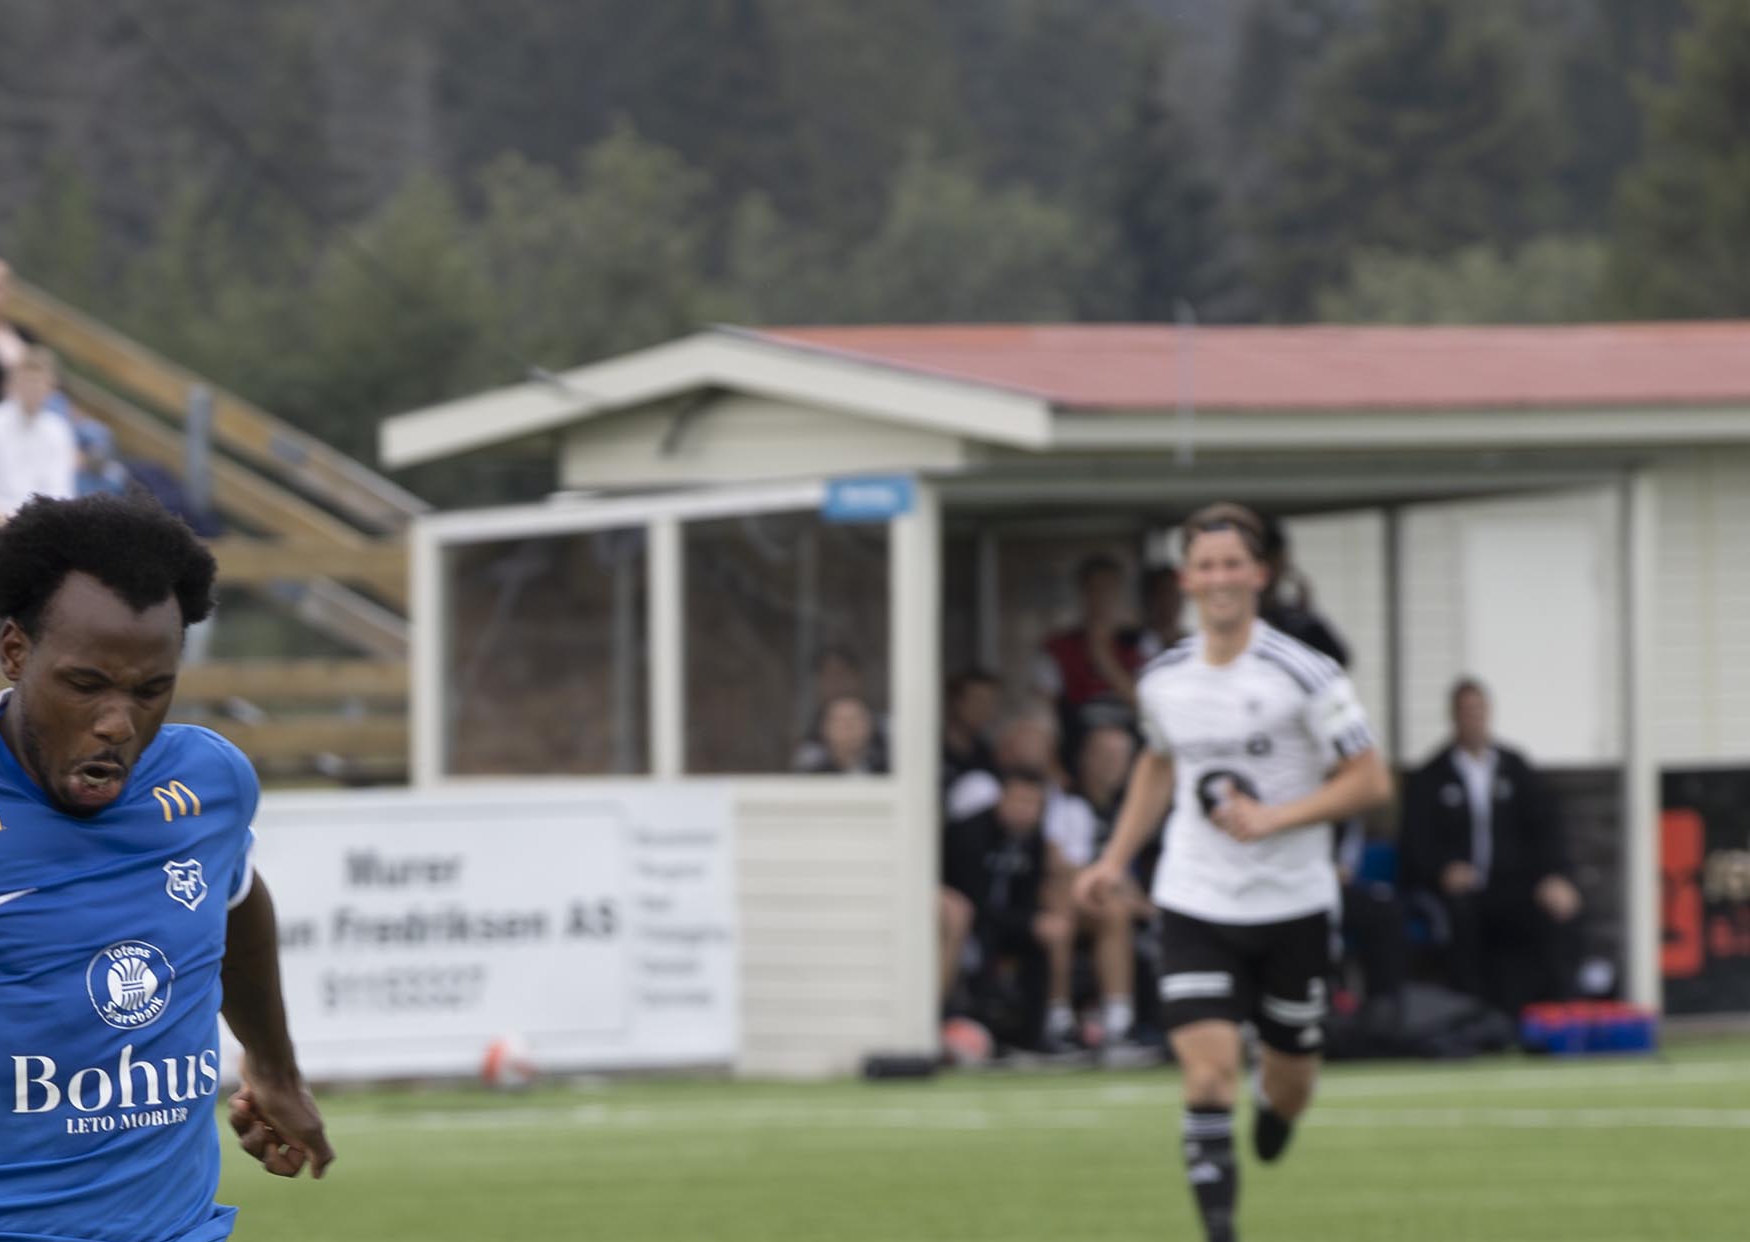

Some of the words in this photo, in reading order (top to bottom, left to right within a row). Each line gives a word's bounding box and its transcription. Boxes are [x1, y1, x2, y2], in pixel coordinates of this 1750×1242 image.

[104, 945, 151, 961] Totens
[11, 1044, 218, 1113] Bohus
[66, 1115, 115, 1134] LETO
